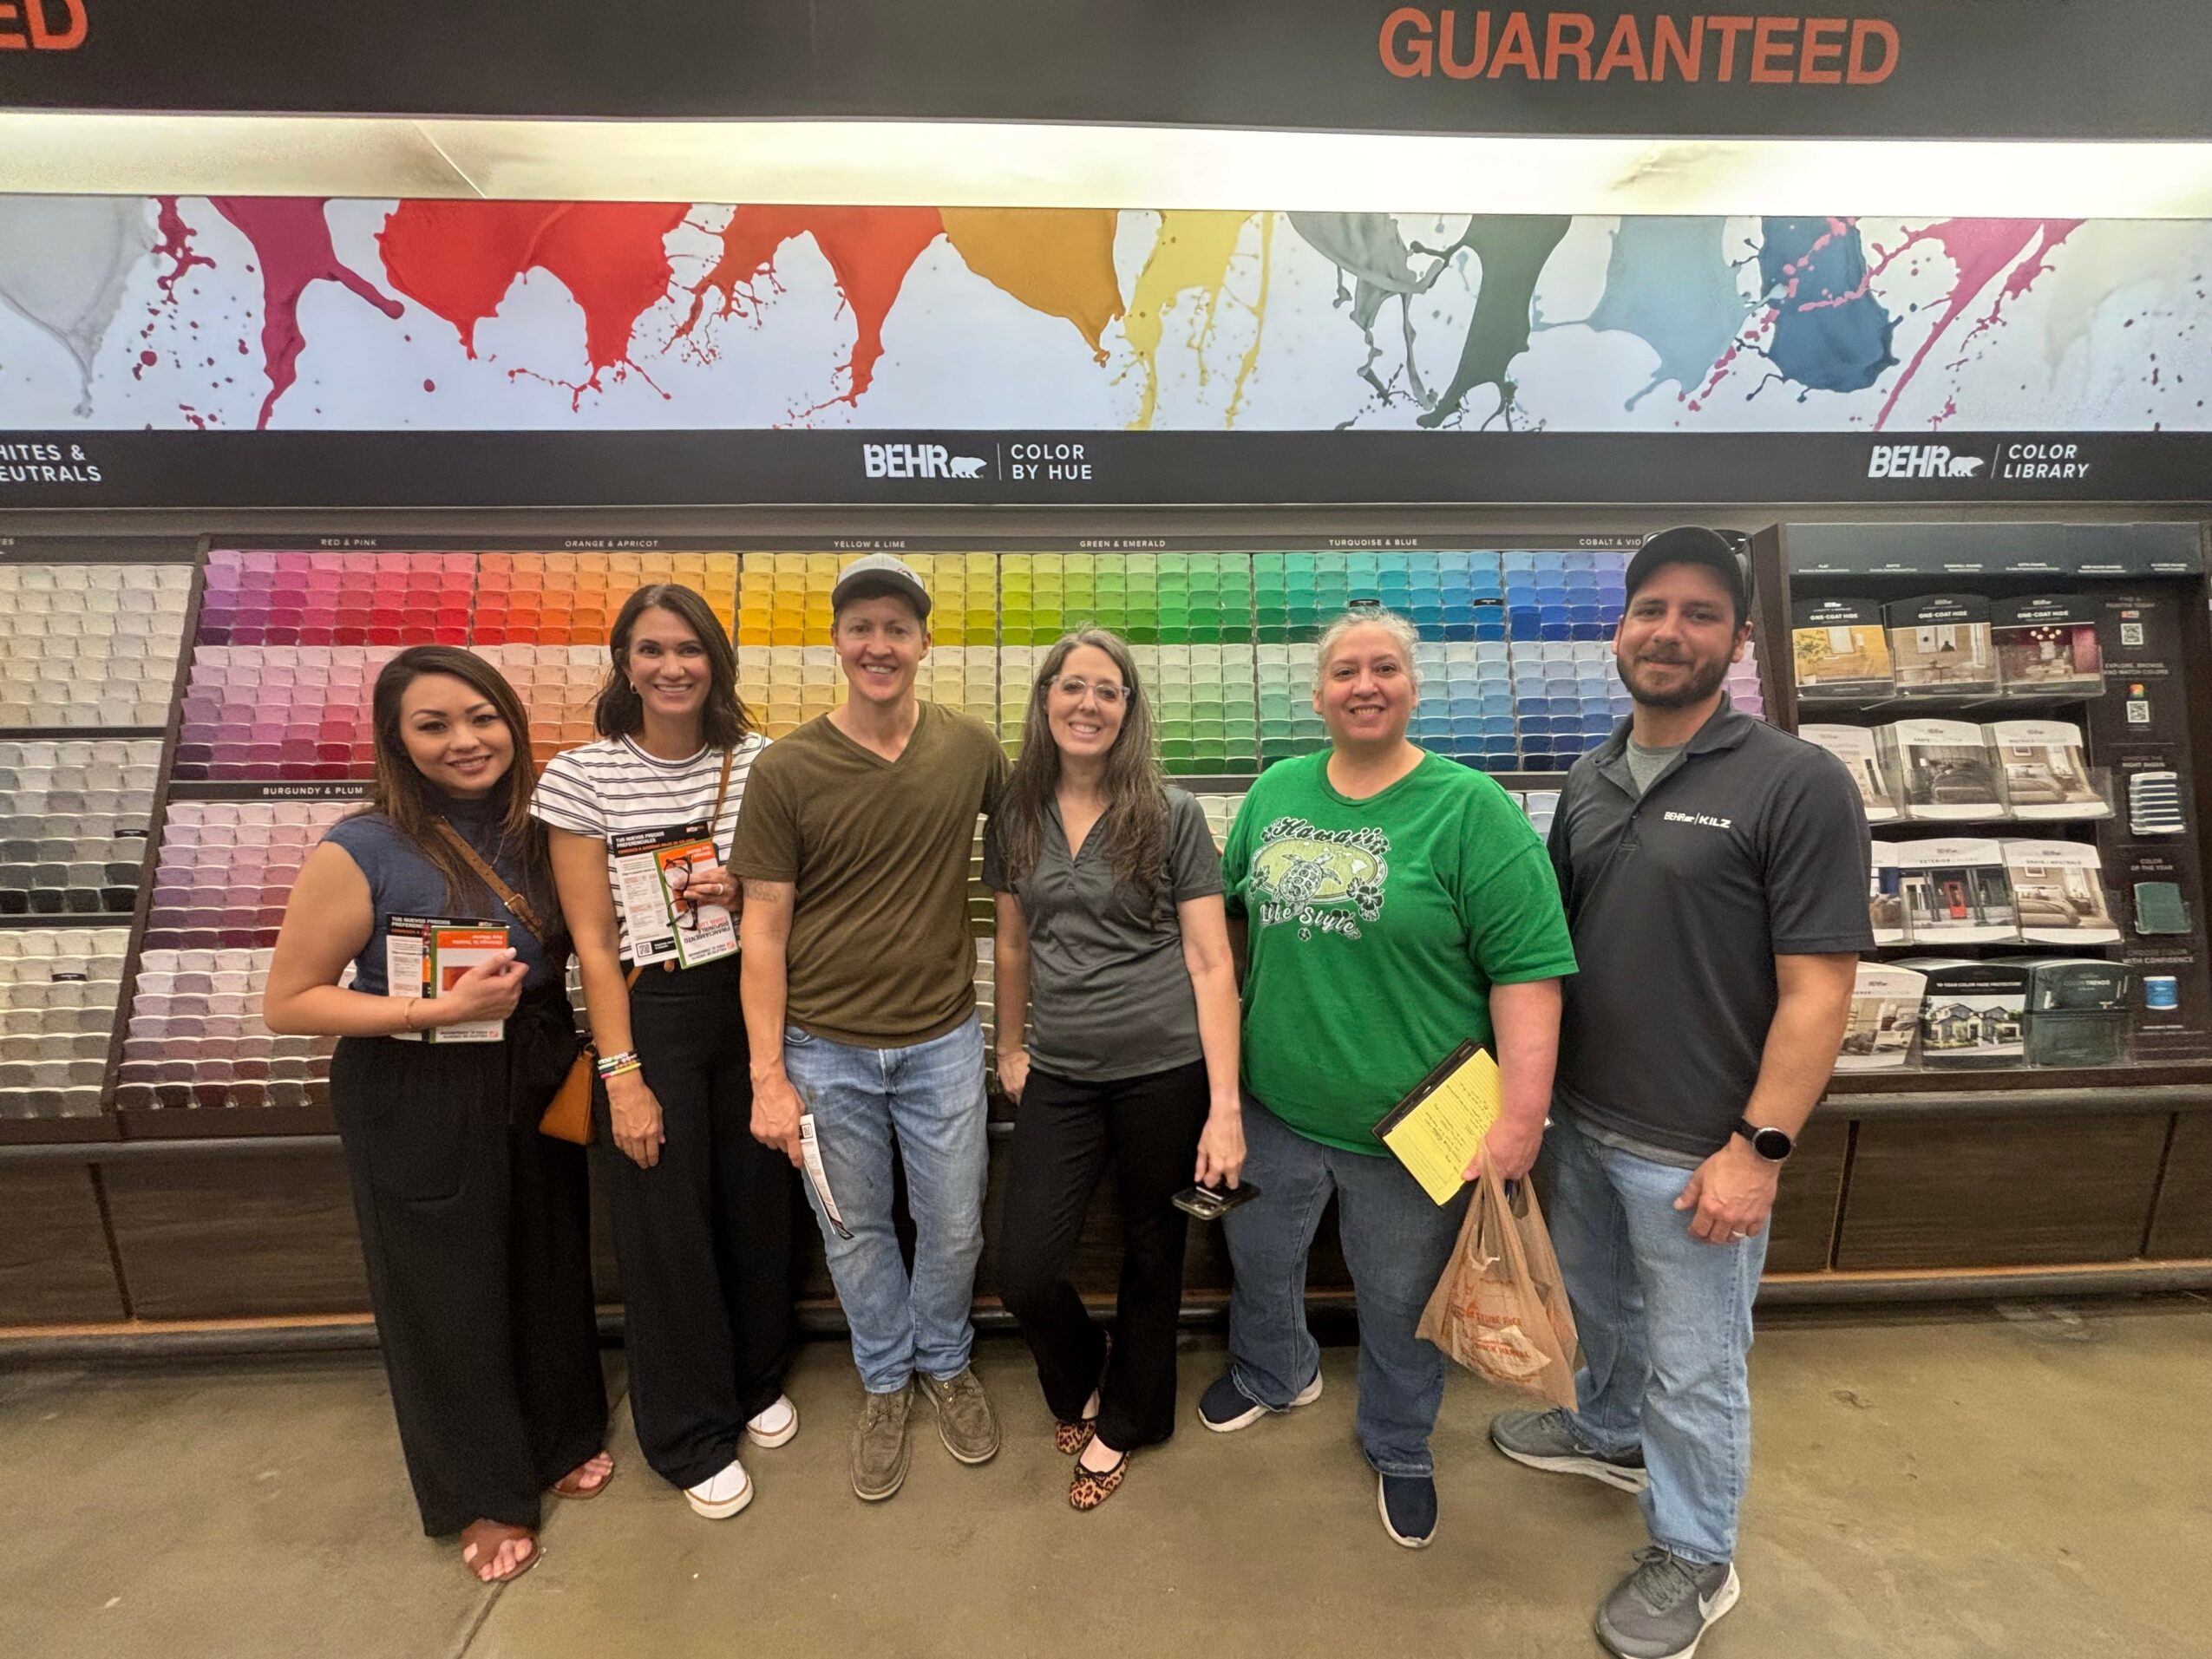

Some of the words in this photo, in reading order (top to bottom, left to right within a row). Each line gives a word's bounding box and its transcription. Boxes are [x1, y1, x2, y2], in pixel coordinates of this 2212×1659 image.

[1378, 7, 1901, 85] GUARANTEED
[71, 443, 86, 460] &
[1011, 443, 1084, 460] COLOR
[2008, 443, 2078, 460] COLOR
[863, 444, 951, 478] BEHR
[1868, 445, 1950, 478] BEHR
[0, 465, 102, 482] EUTRALS
[1012, 464, 1039, 480] BY
[1049, 464, 1092, 480] HUE
[2003, 463, 2090, 479] LIBRARY
[321, 539, 341, 547] RED
[344, 539, 350, 547] &
[354, 539, 377, 547] PINK
[565, 539, 605, 548] ORANGE
[1079, 539, 1109, 548] GREEN
[1114, 539, 1121, 548] &
[1123, 539, 1166, 548] EMERALD
[1329, 539, 1382, 547] TURQUOISE
[1579, 538, 1614, 546] COBALT
[1617, 538, 1623, 546] &
[263, 787, 321, 795] BURGUNDY
[1664, 812, 1686, 821] BEHR
[1698, 815, 1731, 829] KILZ
[1273, 817, 1382, 845] Hawaii
[1260, 902, 1293, 923] Life
[1299, 906, 1356, 933] Style
